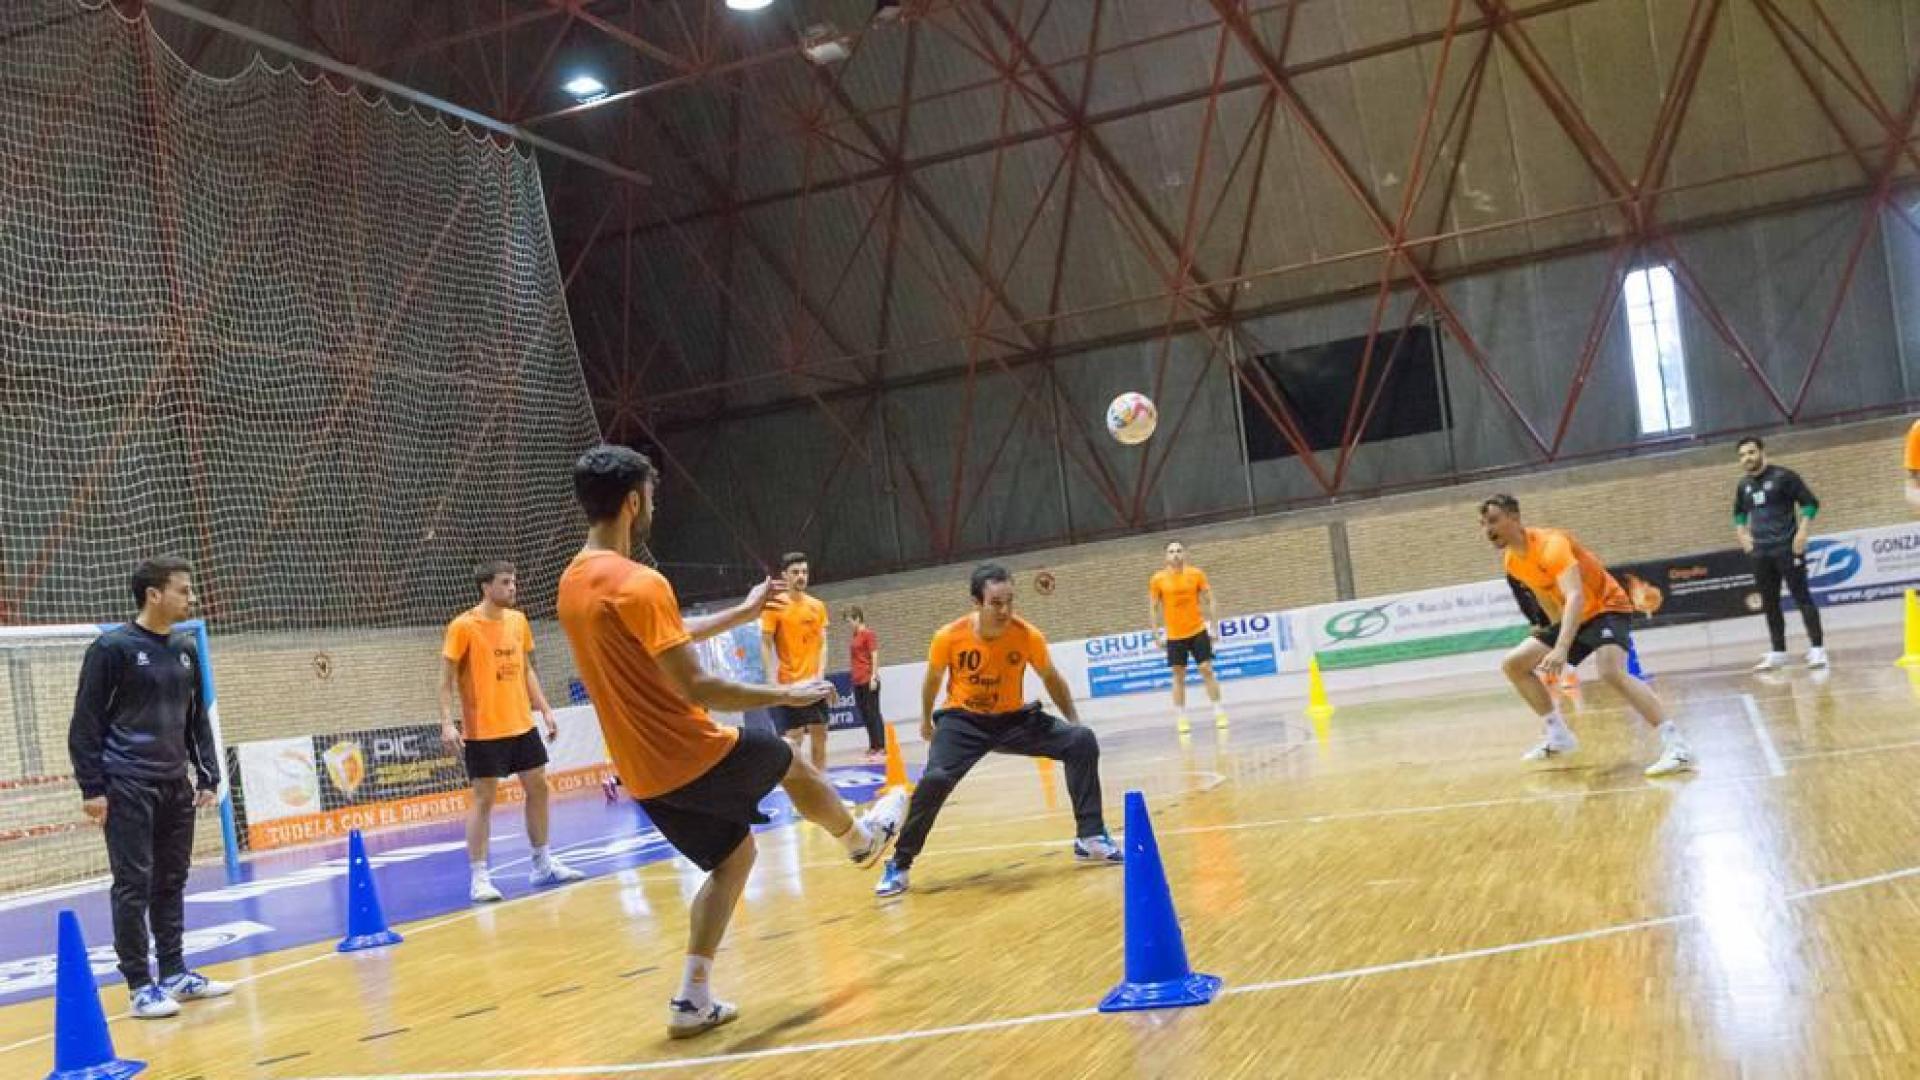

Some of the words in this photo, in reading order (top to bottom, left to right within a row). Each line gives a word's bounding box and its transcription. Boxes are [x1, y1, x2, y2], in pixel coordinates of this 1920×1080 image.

[1219, 614, 1270, 637] BIO
[958, 649, 981, 671] 10
[268, 819, 335, 845] TUDELA
[340, 810, 376, 830] CON
[380, 805, 397, 825] EL
[402, 795, 467, 821] DEPORTE
